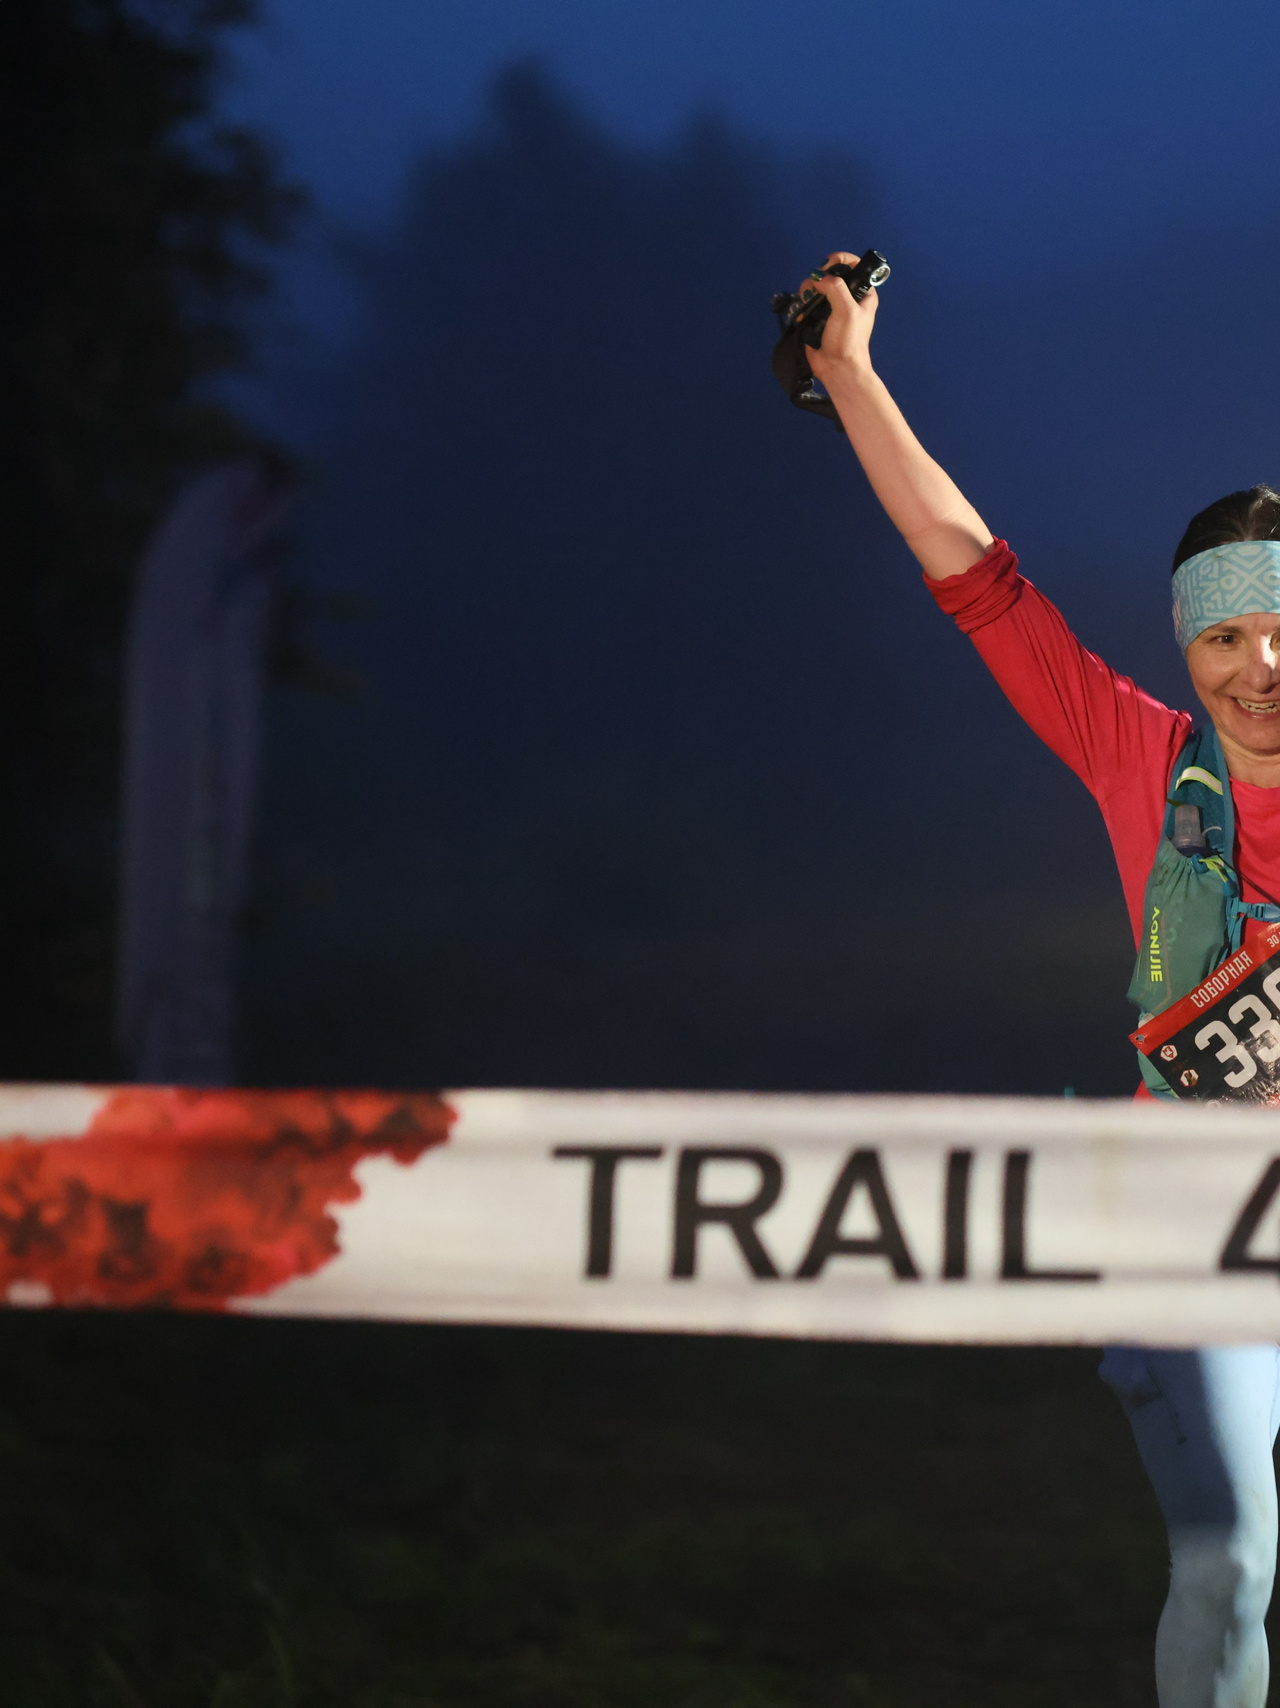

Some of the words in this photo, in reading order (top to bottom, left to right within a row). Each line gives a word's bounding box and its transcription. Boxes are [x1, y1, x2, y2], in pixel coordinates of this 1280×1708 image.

[1150, 905, 1163, 982] AONIJIE
[1190, 950, 1254, 1008] СОБОРНАЯ
[1267, 934, 1280, 948] 30
[551, 1145, 1104, 1283] TRAIL
